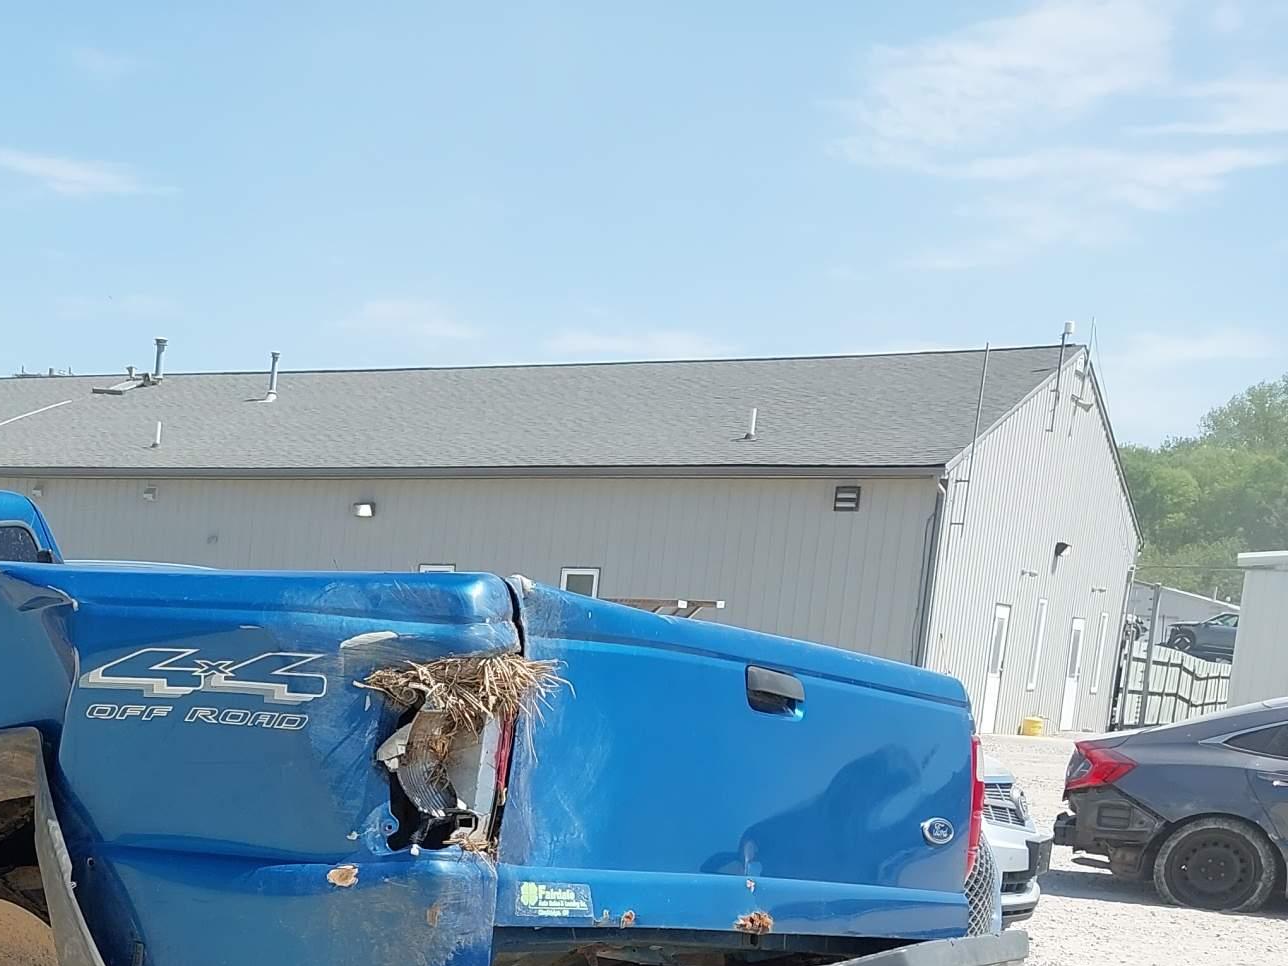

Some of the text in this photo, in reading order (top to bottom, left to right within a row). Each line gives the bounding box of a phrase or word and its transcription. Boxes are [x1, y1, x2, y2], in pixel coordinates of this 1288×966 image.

[79, 647, 328, 705] 4x4
[86, 703, 309, 731] OFF ROAD
[932, 822, 950, 838] Ford
[538, 884, 576, 900] Fairdale
